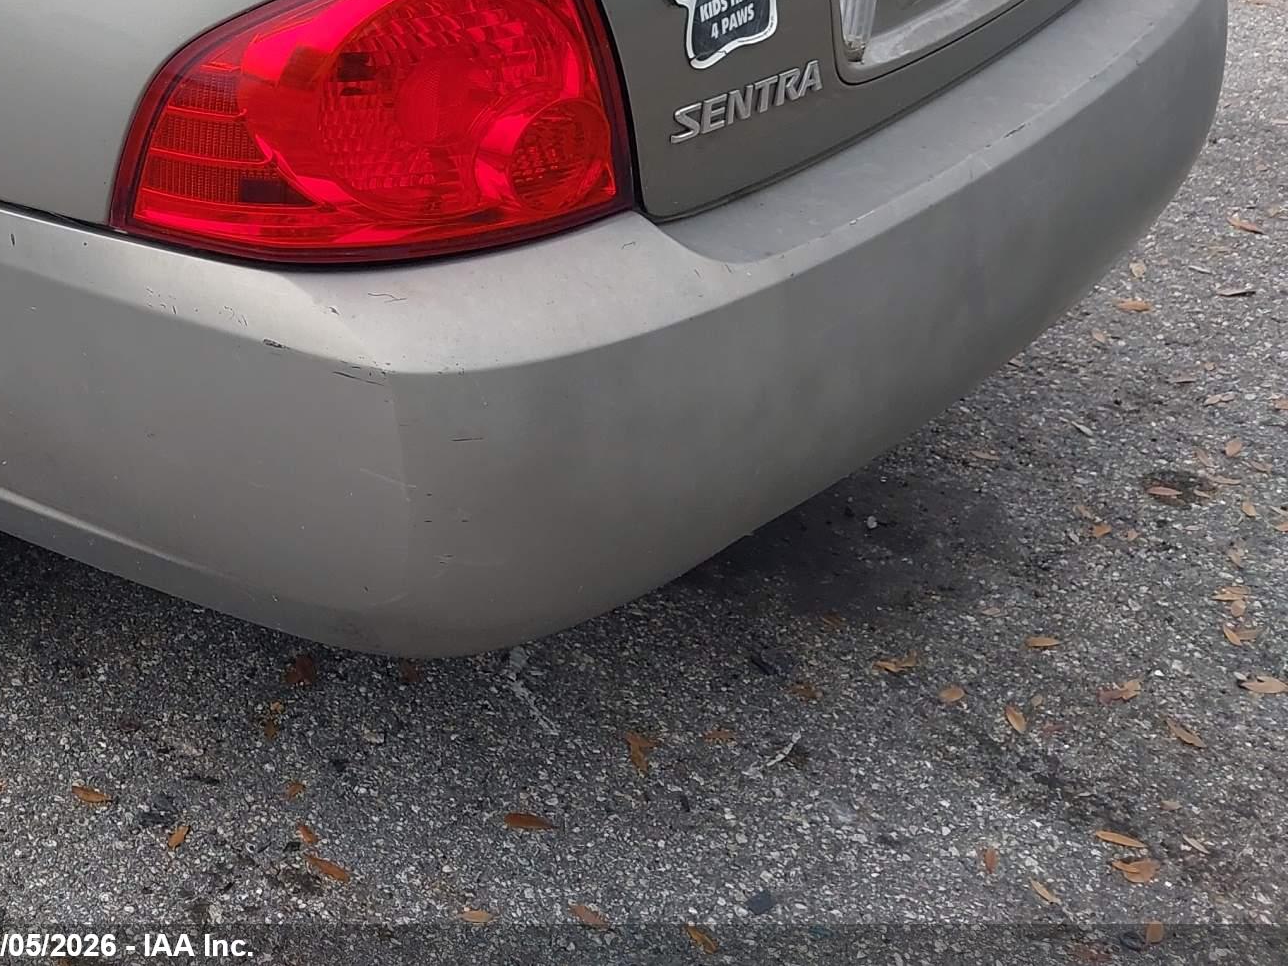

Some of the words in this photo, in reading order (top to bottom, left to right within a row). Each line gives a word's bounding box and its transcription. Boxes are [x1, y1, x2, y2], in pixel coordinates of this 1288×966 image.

[710, 21, 720, 40] 4
[720, 2, 755, 35] PAWS
[670, 59, 823, 144] SENTRA
